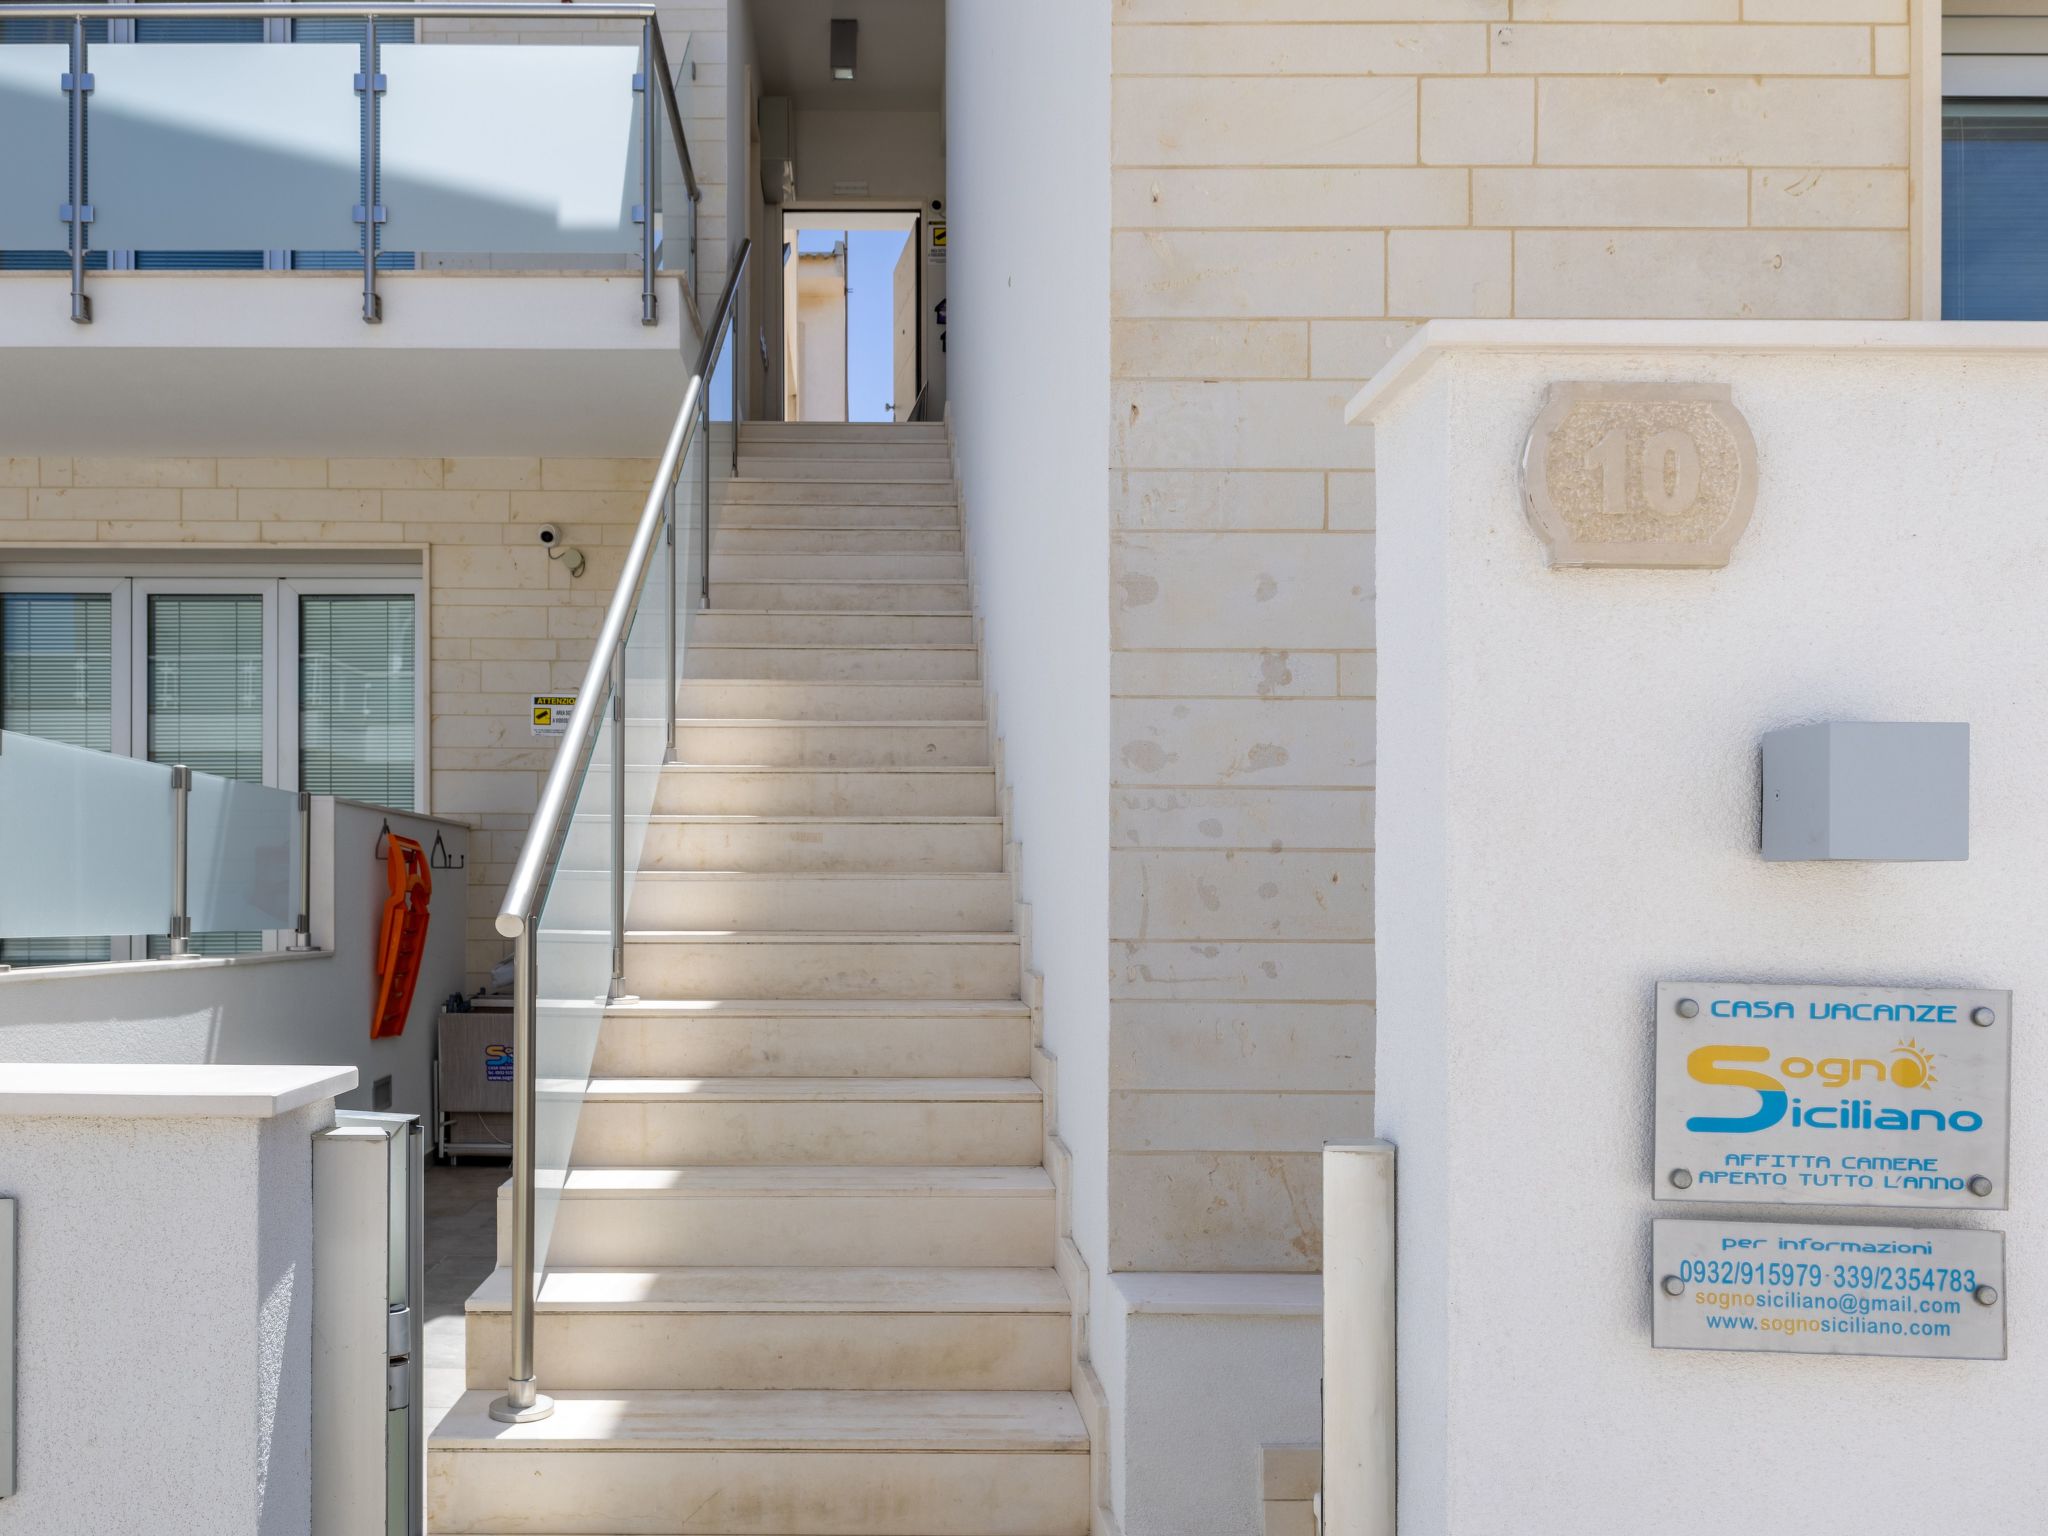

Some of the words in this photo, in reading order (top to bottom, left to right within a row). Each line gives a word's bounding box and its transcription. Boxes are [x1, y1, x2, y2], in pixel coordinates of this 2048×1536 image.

[1585, 430, 1700, 516] 10
[537, 697, 577, 705] ATTENZIO
[1710, 999, 1796, 1019] CASA
[1809, 1002, 1958, 1024] VACANZE
[1724, 1153, 1831, 1168] AFFITTA
[1841, 1155, 1938, 1172] CAMERE
[1699, 1171, 1787, 1185] APERTO
[1799, 1173, 1873, 1188] TUTTO
[1883, 1175, 1966, 1191] L'ANNO
[1722, 1237, 1767, 1250] per
[1778, 1237, 1933, 1255] informazioni
[1696, 1290, 1961, 1314] sognosiciliano@gmail.com
[1707, 1315, 1951, 1337] www.sognosiciliano.com
